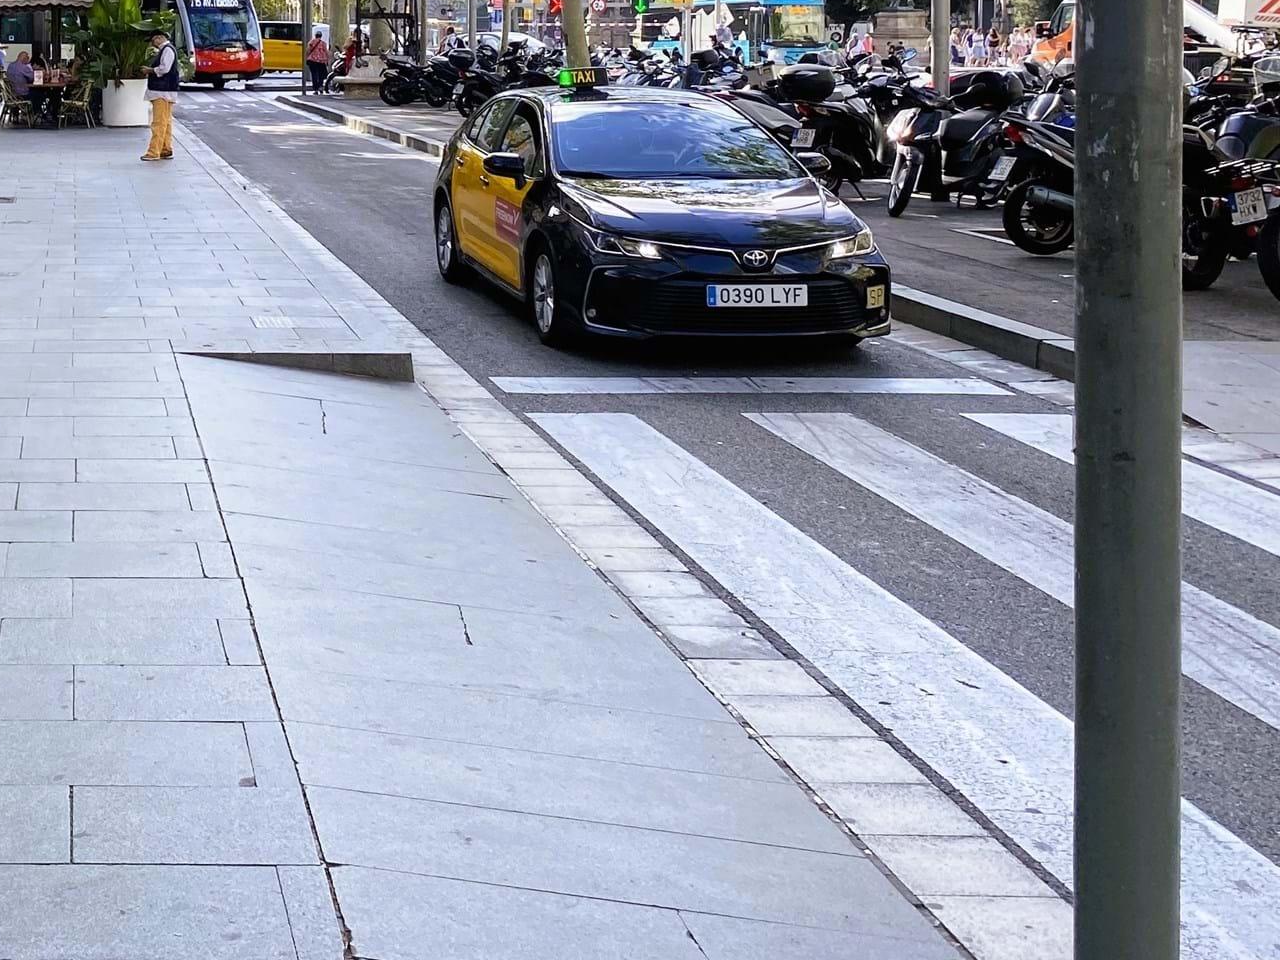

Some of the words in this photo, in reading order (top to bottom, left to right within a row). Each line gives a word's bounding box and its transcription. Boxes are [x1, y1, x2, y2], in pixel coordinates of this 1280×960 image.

[570, 70, 596, 84] TAXI
[1237, 190, 1262, 206] 3732
[720, 287, 765, 304] 0390
[770, 287, 803, 304] LYF
[870, 287, 883, 307] SP
